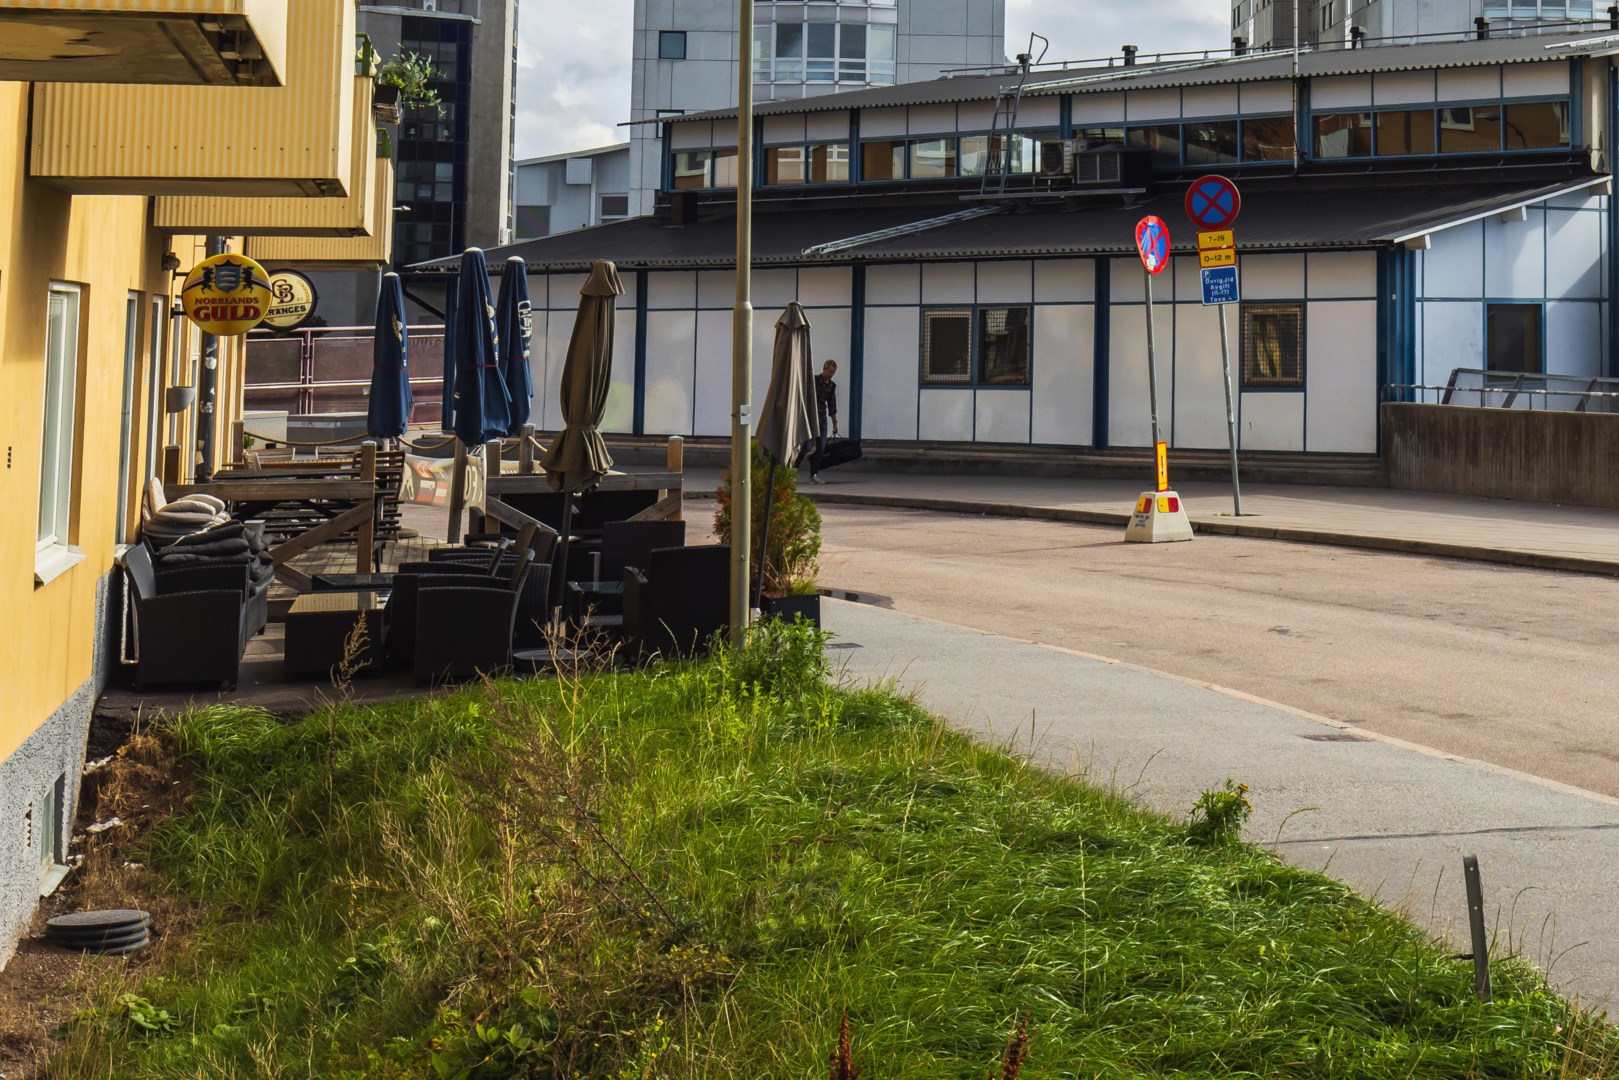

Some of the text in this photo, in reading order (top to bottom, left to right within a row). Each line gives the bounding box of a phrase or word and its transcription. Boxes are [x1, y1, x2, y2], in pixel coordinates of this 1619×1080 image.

[1208, 235, 1224, 243] 7-19
[195, 297, 259, 305] NORRLANDS
[193, 305, 261, 321] GULD
[266, 306, 307, 316] RANGES
